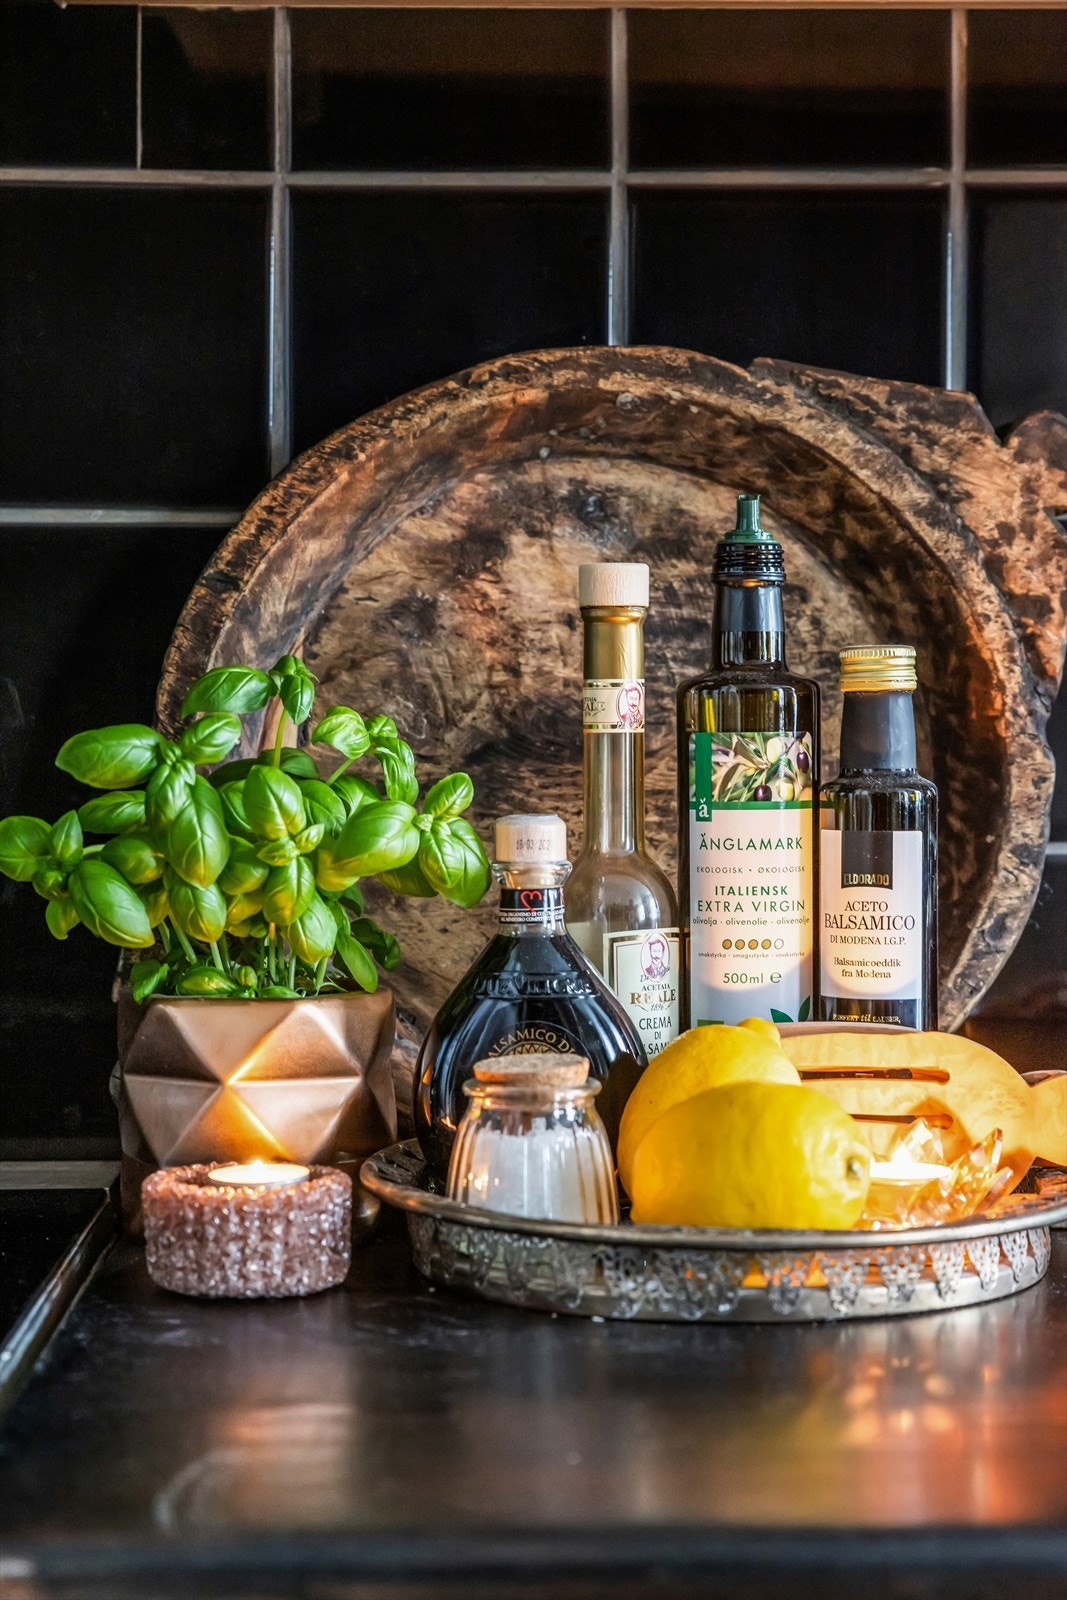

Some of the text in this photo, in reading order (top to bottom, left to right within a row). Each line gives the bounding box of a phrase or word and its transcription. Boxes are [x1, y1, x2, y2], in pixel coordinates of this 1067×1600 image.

[696, 865, 806, 874] EKOLOGISK ØKOLOGISK
[843, 873, 890, 886] ELDORADO
[715, 885, 788, 896] ITALIENSK
[697, 899, 805, 912] EXTRA VIRGIN
[844, 901, 889, 912] ACETO
[725, 917, 768, 926] olivenolie
[824, 913, 916, 930] BALSAMICO
[830, 934, 906, 945] DI MODENA I.G.P.
[834, 957, 901, 968] Balsamicoeddik
[722, 972, 764, 984] 500ml
[841, 969, 891, 979] fra Modena
[629, 989, 676, 1005] REALE
[638, 1016, 672, 1030] CREMA
[654, 1031, 662, 1040] DI
